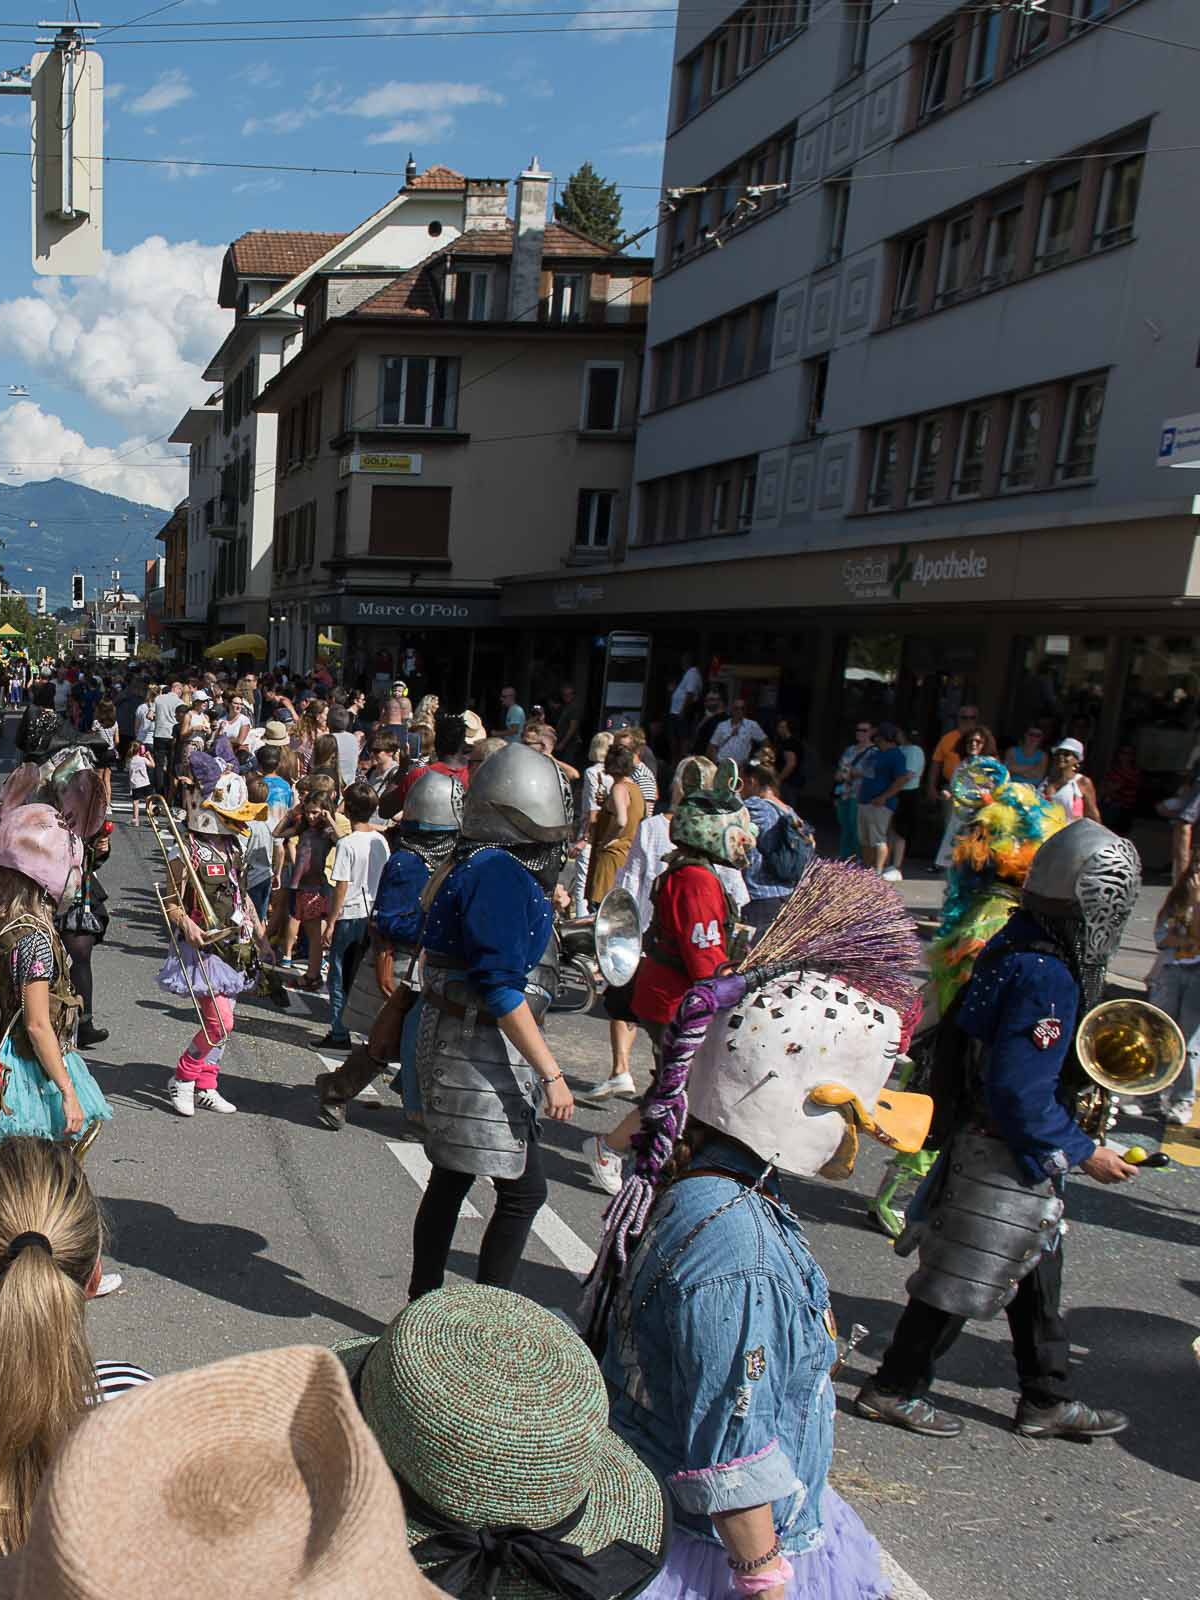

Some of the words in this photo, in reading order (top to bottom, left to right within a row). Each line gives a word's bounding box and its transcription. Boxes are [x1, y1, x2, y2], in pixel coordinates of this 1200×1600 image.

[363, 455, 388, 465] GOLD
[911, 549, 987, 587] Apotheke
[357, 602, 405, 616] Marc
[410, 602, 469, 617] O'Polo
[691, 919, 721, 949] 44
